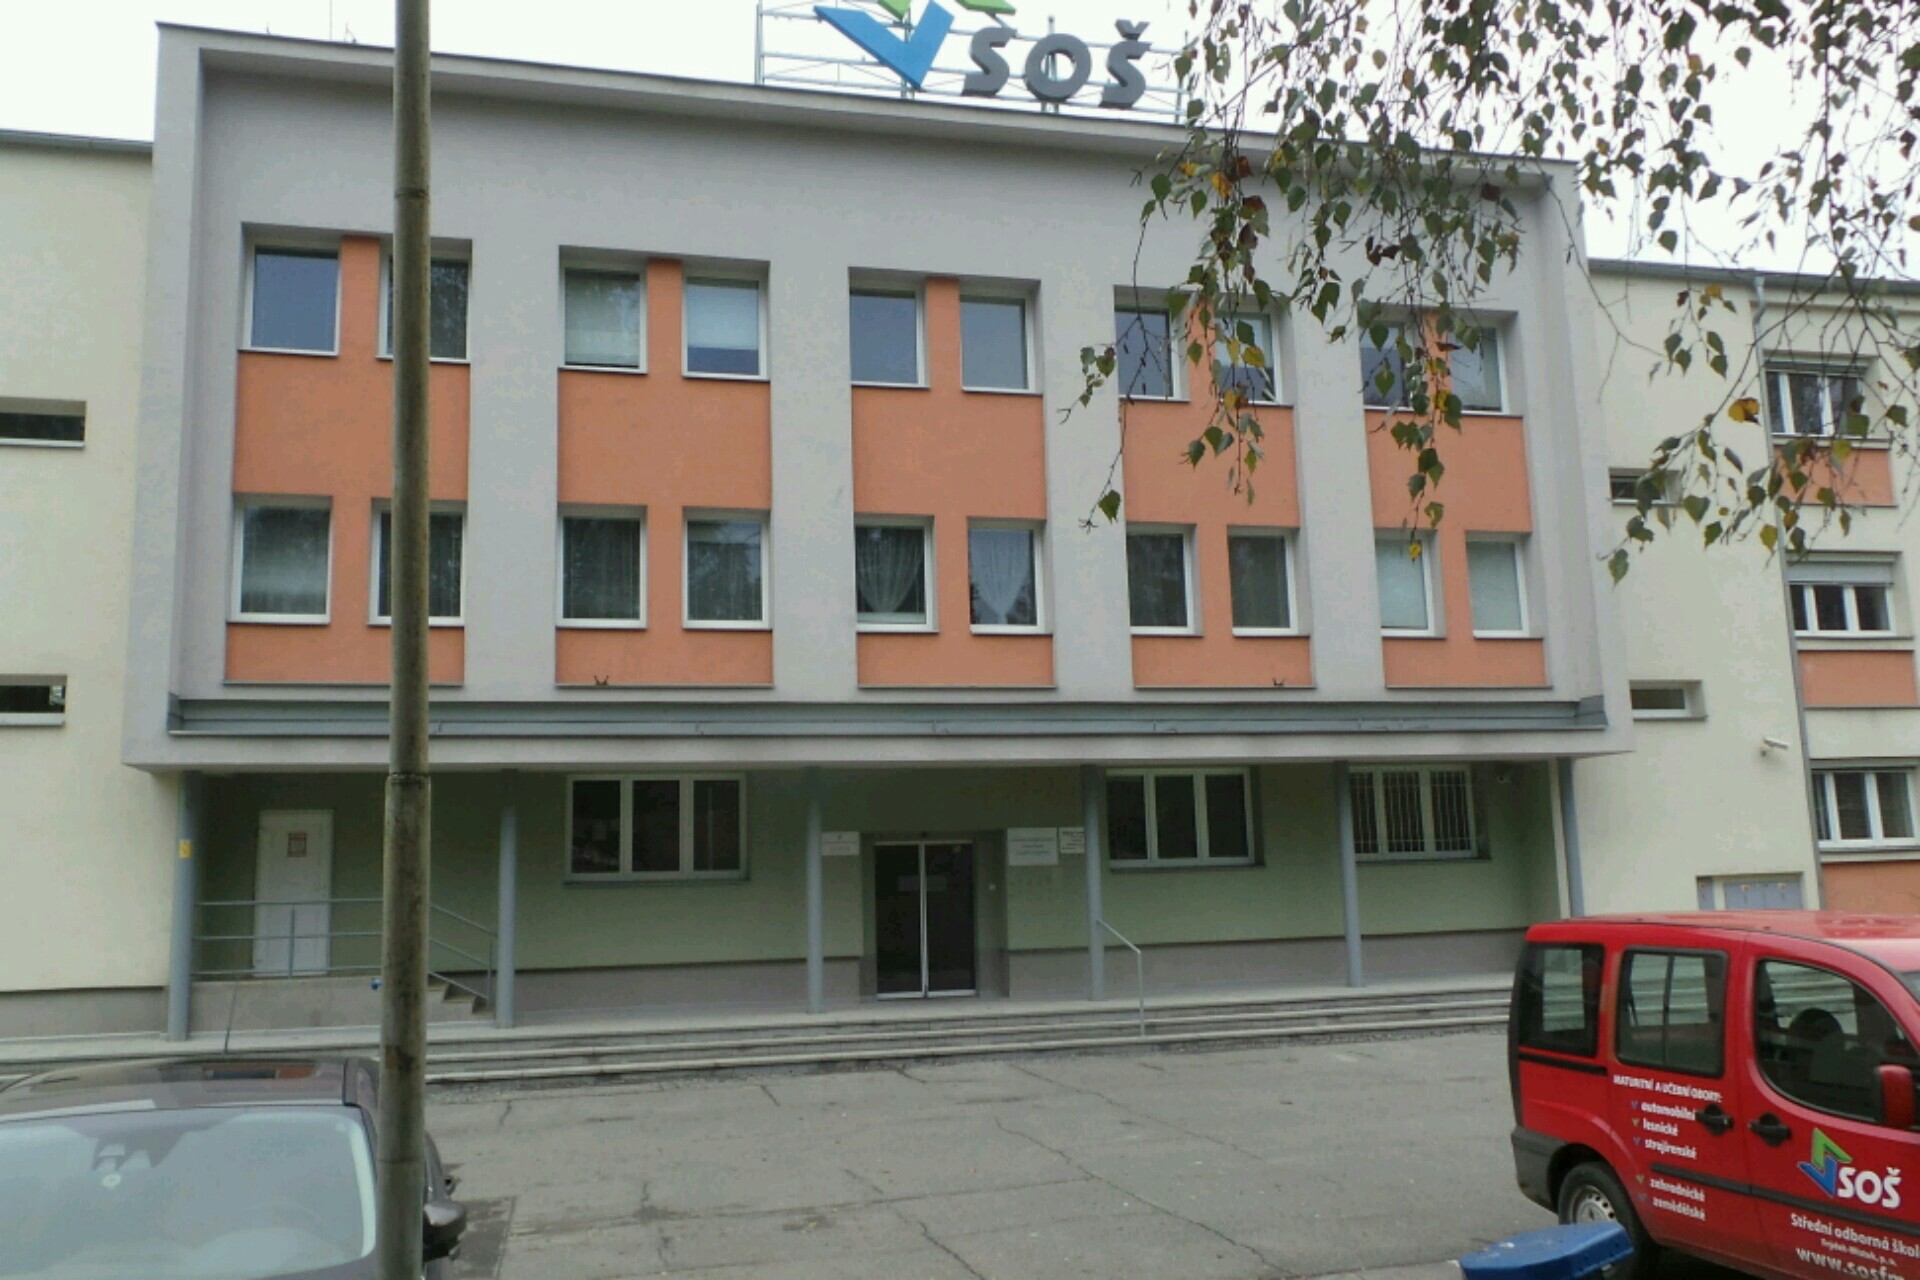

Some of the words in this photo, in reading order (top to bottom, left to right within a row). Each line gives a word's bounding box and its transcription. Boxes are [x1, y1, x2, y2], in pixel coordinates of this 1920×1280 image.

[961, 19, 1153, 109] SOŠ
[1641, 1102, 1696, 1121] automobilní
[1837, 1166, 1902, 1210] SOŠ
[1791, 1213, 1832, 1236] Střední
[1834, 1226, 1889, 1251] odborná
[1892, 1238, 1920, 1259] škol
